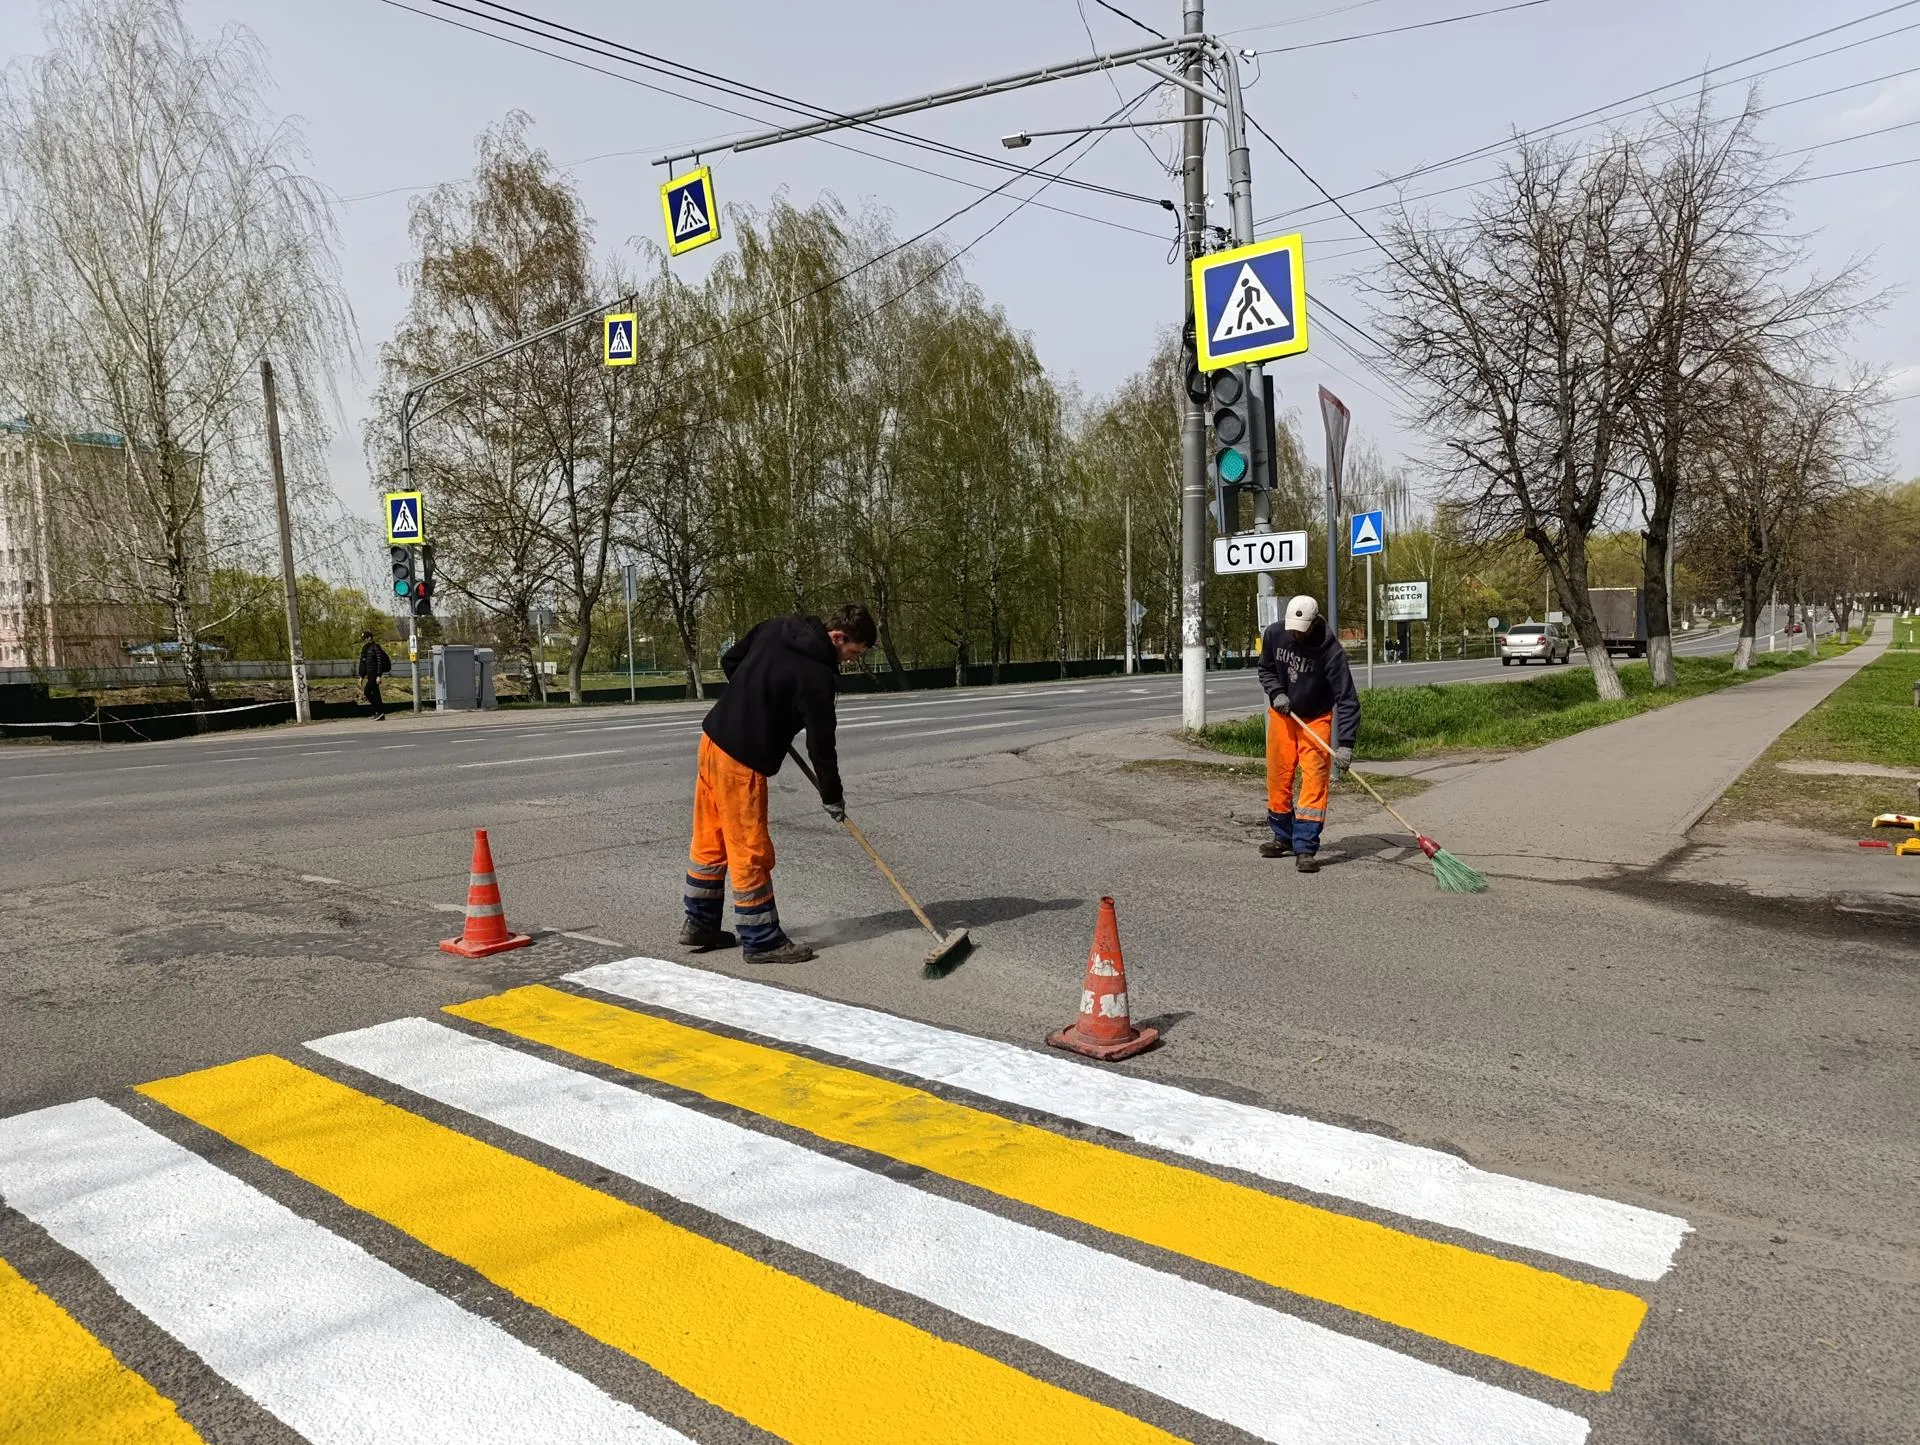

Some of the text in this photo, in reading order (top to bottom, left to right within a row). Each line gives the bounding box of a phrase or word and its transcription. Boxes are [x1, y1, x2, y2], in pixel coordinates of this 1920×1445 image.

[1227, 540, 1293, 566] СТОП
[1383, 593, 1422, 601] ДАЕТСЯ
[1276, 647, 1316, 673] RUSSIA
